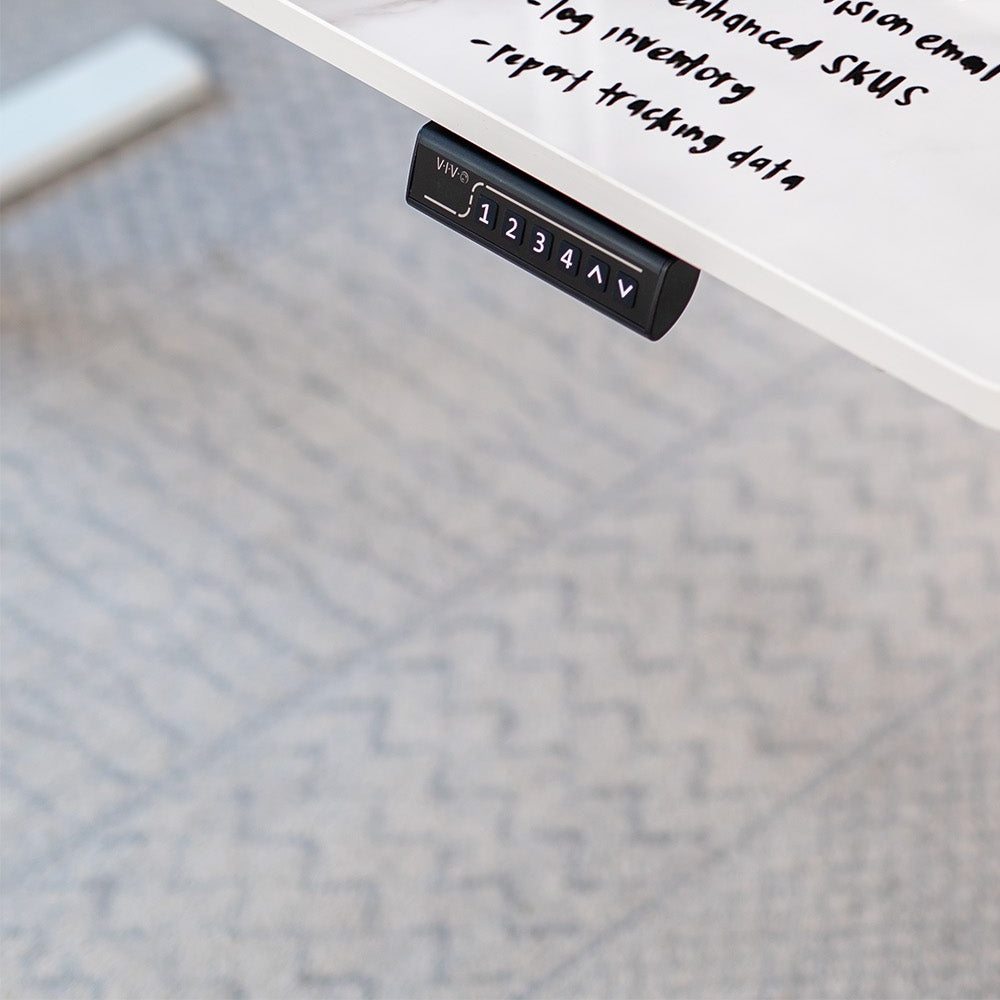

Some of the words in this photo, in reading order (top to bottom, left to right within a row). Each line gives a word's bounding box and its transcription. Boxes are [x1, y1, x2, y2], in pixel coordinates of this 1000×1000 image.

[600, 26, 756, 104] inventory
[596, 82, 726, 154] tracking
[727, 145, 806, 191] data
[478, 203, 490, 225] 1
[505, 217, 518, 240] 2
[533, 231, 546, 253] 3
[560, 248, 573, 269] 4
